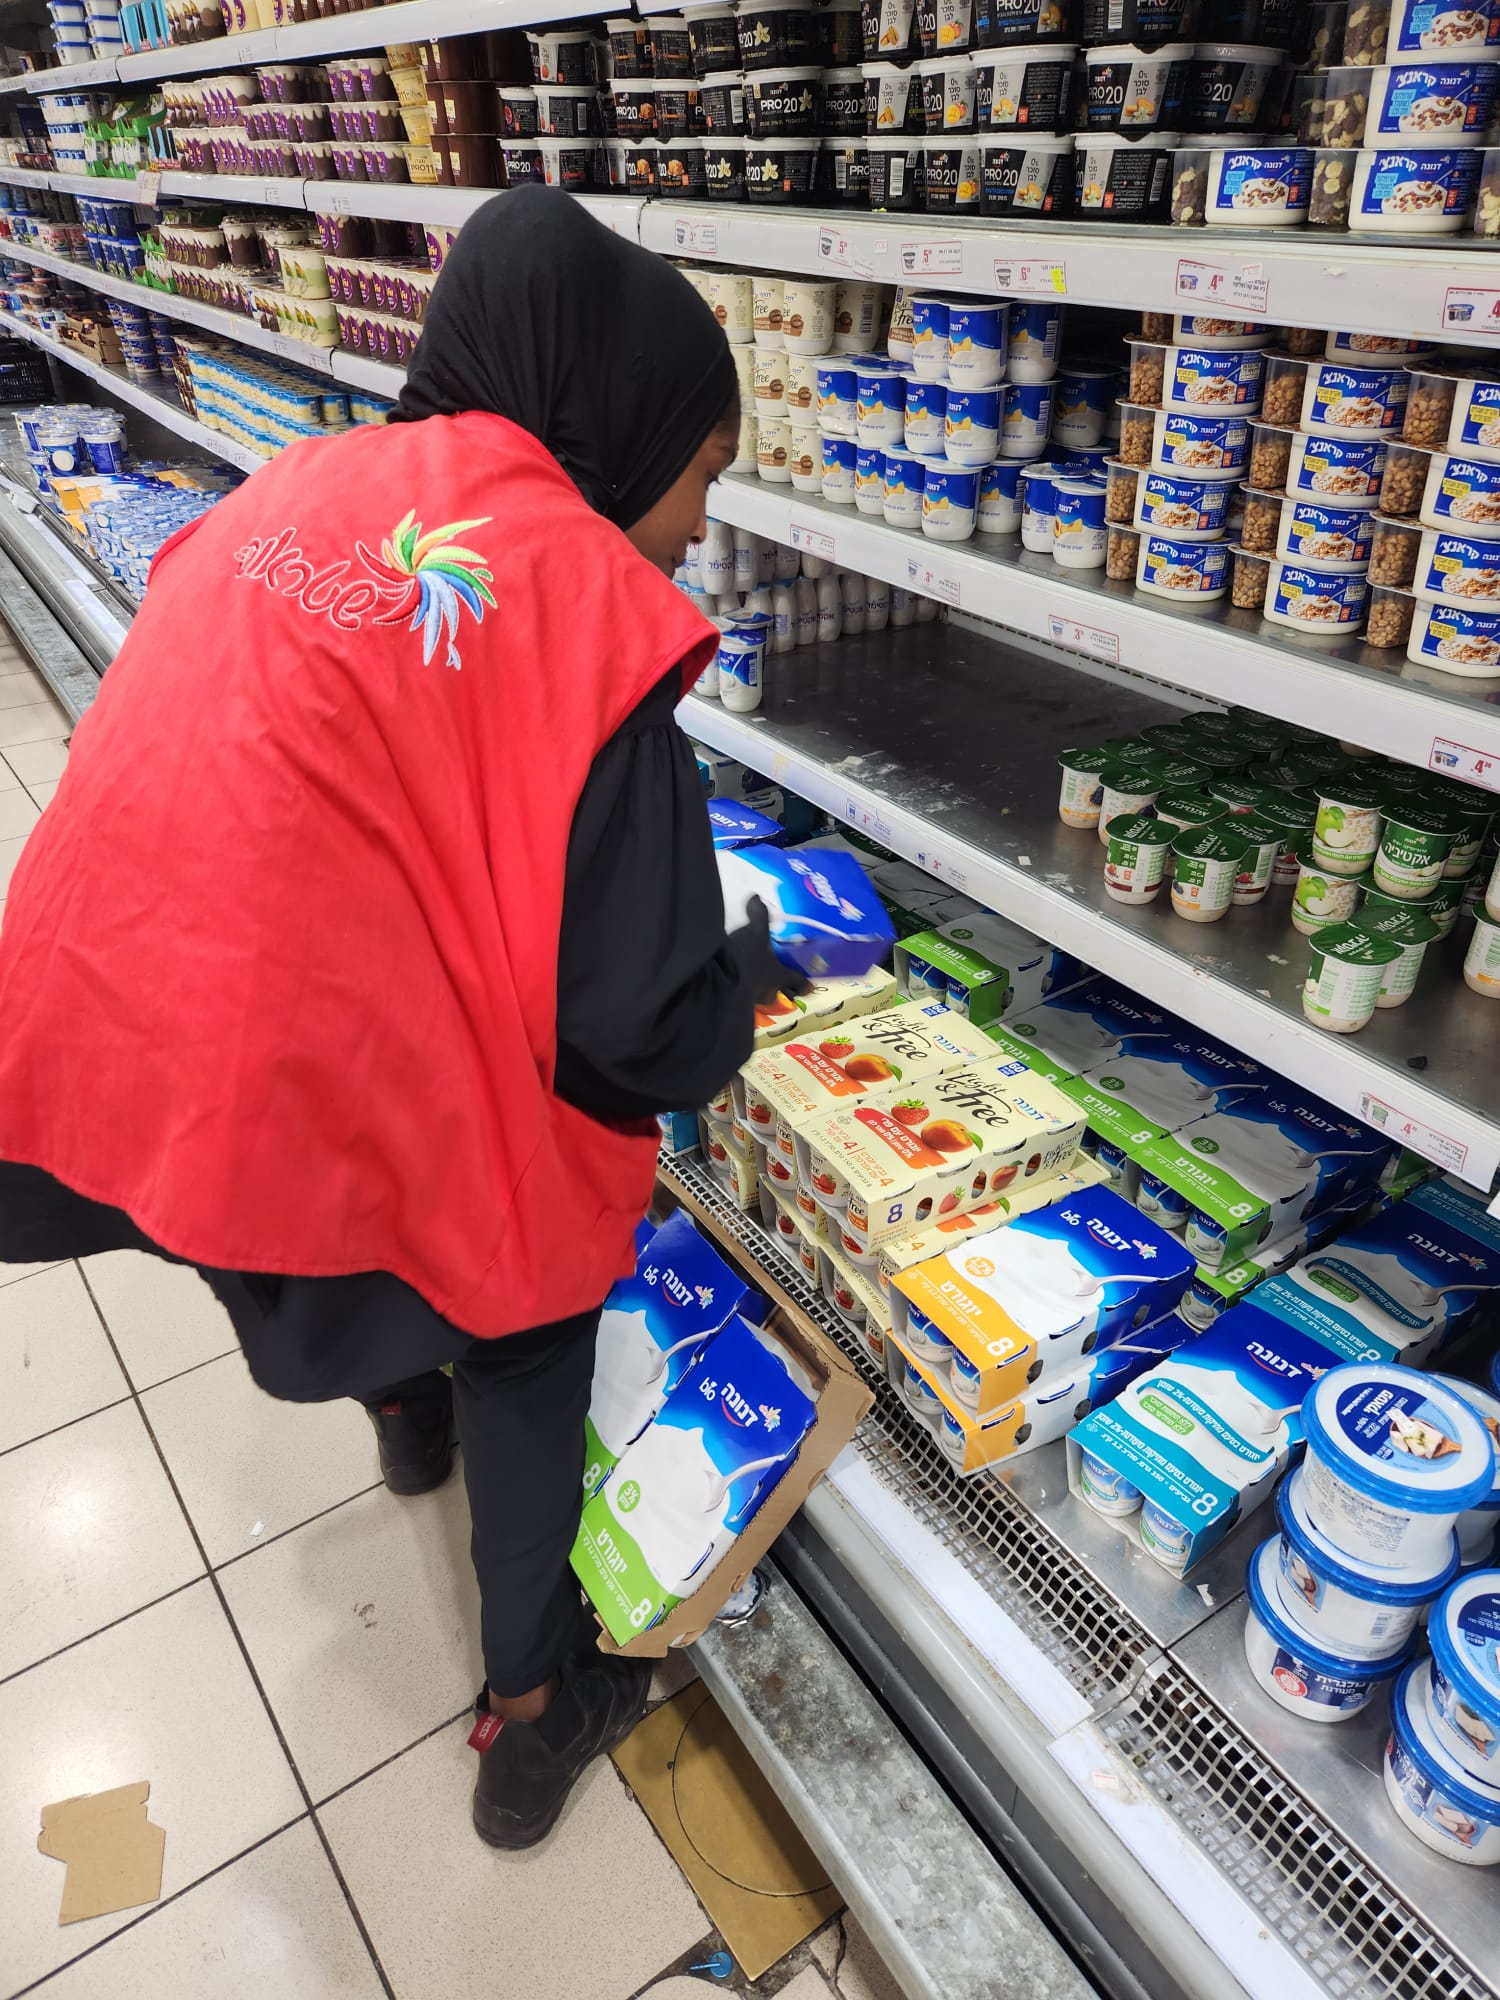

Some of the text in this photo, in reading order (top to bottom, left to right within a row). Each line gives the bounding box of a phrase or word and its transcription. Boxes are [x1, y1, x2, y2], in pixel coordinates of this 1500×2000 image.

[1136, 88, 1147, 96] לבן
[1385, 842, 1431, 866] אקטיביה
[972, 968, 991, 980] 8
[932, 1034, 962, 1056] דנונה
[1173, 1042, 1237, 1070] דנונה bio
[772, 1069, 786, 1082] 4
[944, 1071, 1007, 1096] Light
[802, 1100, 817, 1112] 4
[1012, 1097, 1045, 1121] דנונה
[1082, 1093, 1122, 1119] יוגורט
[1268, 1100, 1338, 1133] דנונה bio
[879, 1116, 923, 1153] יוגורט עם פרי
[1130, 1130, 1153, 1144] 8
[843, 1141, 858, 1155] 4
[879, 1174, 895, 1188] 4
[1173, 1155, 1219, 1189] יוגורט
[887, 1204, 903, 1224] 8
[1229, 1203, 1253, 1219] 8
[1060, 1210, 1132, 1252] דנונה bio
[1408, 1233, 1460, 1264] דנונה
[643, 1265, 694, 1306] דנונה bio
[1267, 1281, 1284, 1295] שומן
[940, 1280, 982, 1317] יוגורט
[1310, 1309, 1333, 1328] מתיקות
[1330, 1322, 1350, 1338] בטעם
[986, 1336, 1015, 1356] 8
[1348, 1333, 1368, 1350] יוגורט
[1246, 1341, 1303, 1378] דנונה
[1156, 1379, 1174, 1395] שומן
[699, 1377, 759, 1428] דנונה bio
[1095, 1411, 1113, 1428] שומן
[1200, 1412, 1226, 1434] מתיקות
[1220, 1430, 1242, 1448] בטעם
[1140, 1445, 1168, 1468] מתיקות
[1238, 1444, 1261, 1462] יוגורט
[582, 1462, 601, 1489] 8
[1164, 1462, 1186, 1481] בטעם
[624, 1484, 639, 1500] 3%
[1182, 1476, 1204, 1494] יוגורט
[1191, 1492, 1219, 1516] 8
[598, 1528, 628, 1573] יוגורט
[629, 1598, 652, 1627] 8
